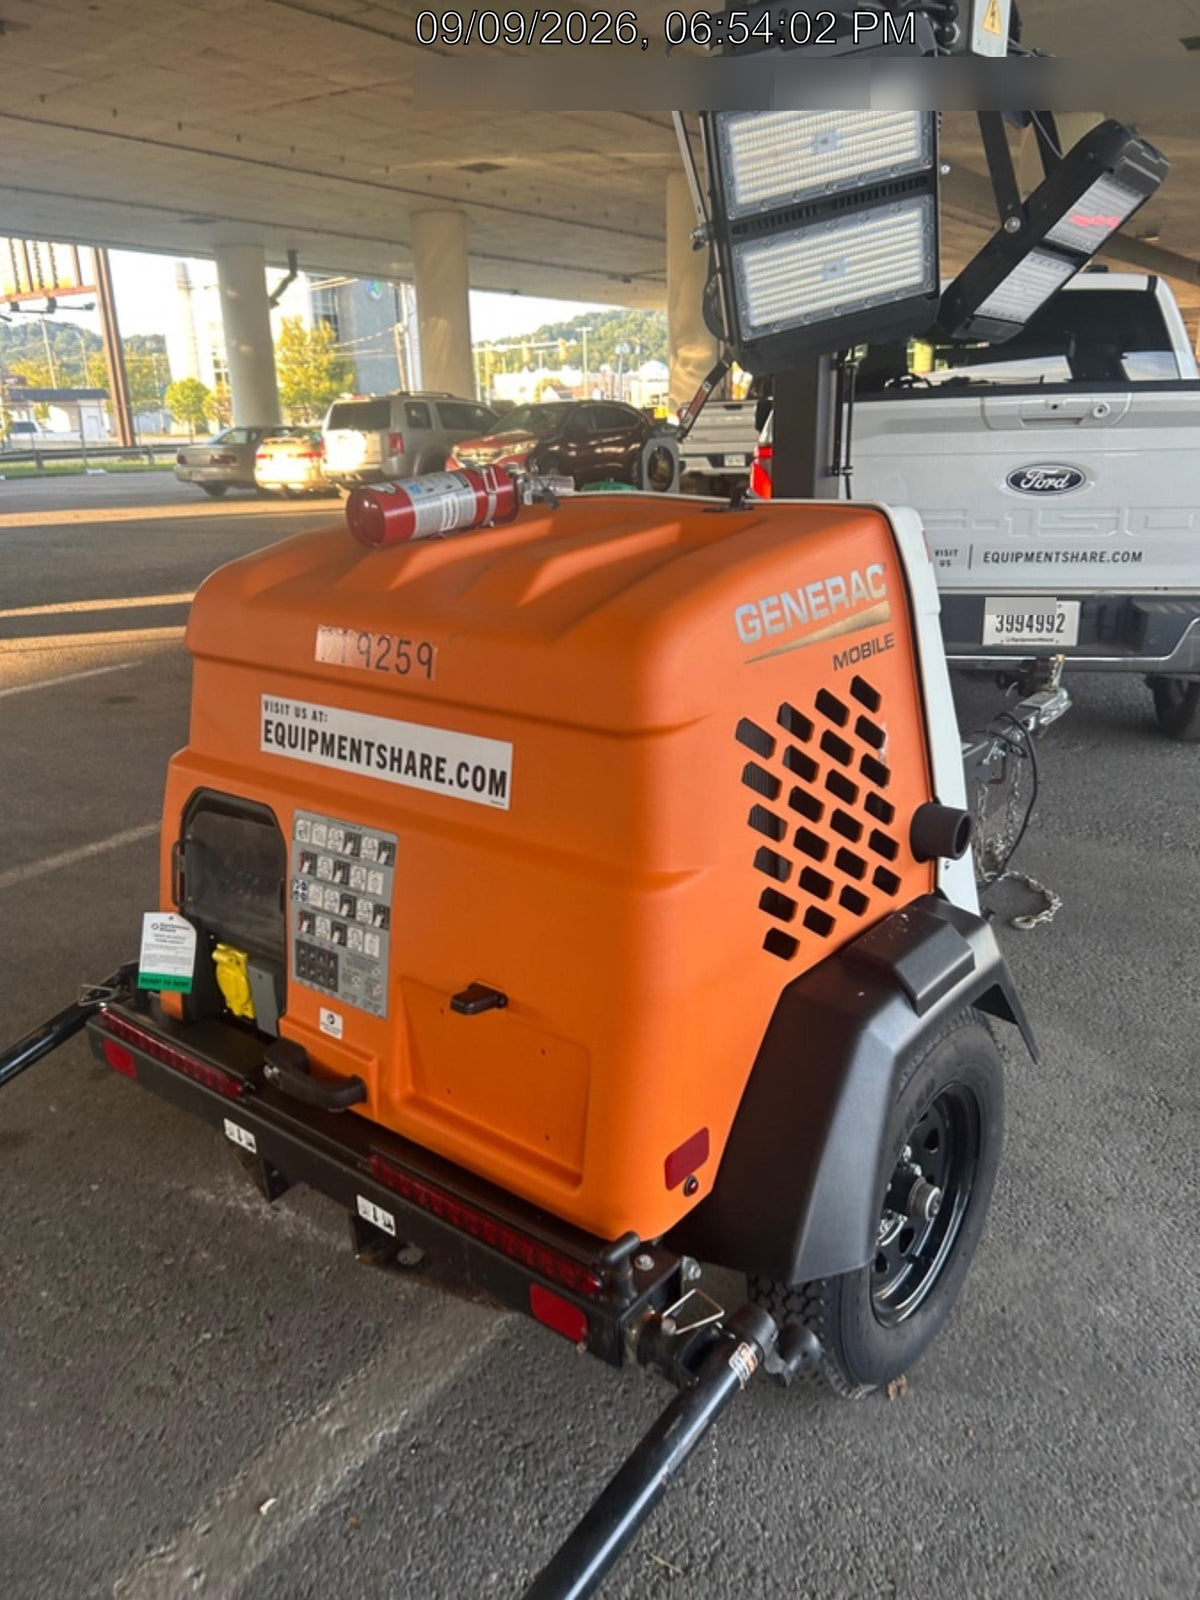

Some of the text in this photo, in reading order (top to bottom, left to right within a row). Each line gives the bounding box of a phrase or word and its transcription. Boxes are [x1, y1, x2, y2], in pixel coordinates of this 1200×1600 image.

[1020, 468, 1069, 490] Ford
[934, 548, 958, 557] VISIT
[939, 559, 951, 568] US
[983, 550, 1143, 564] EQUIPMENTSHARE.COM
[734, 563, 887, 644] GENERAC
[995, 613, 1066, 633] 3994992
[832, 633, 895, 671] MOBILE
[263, 700, 328, 723] VISIT US AT:
[263, 719, 507, 799] EQUIPMENTSHARE.COM
